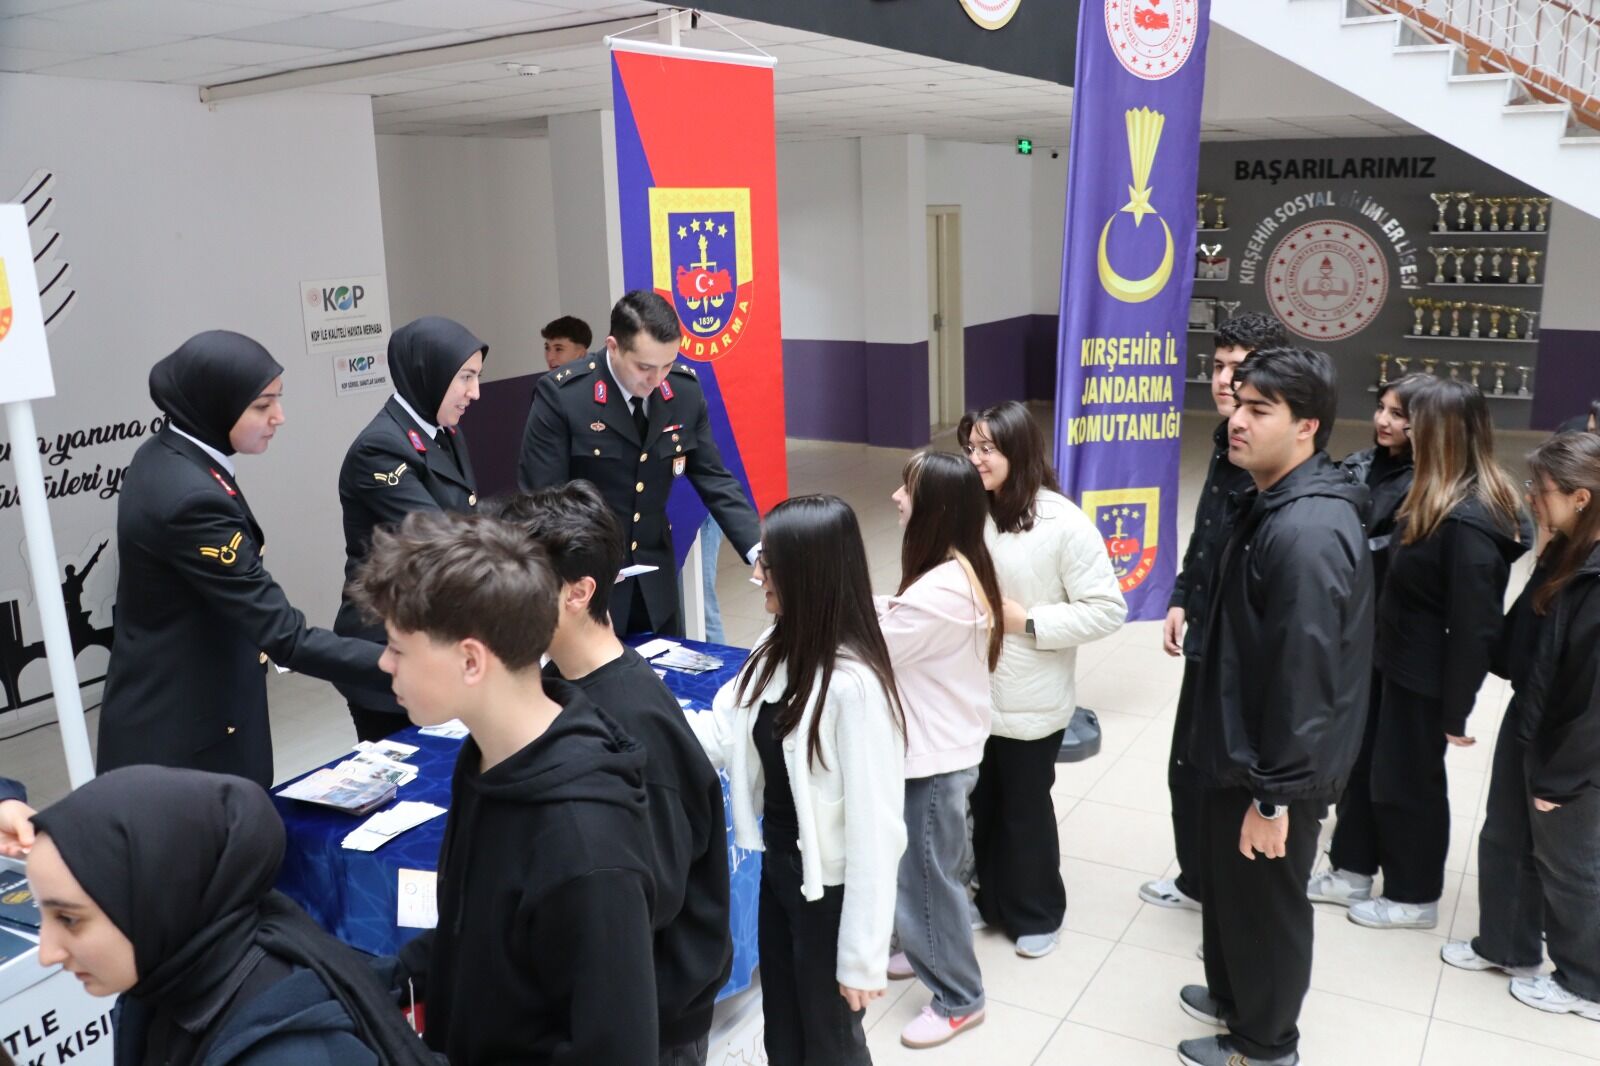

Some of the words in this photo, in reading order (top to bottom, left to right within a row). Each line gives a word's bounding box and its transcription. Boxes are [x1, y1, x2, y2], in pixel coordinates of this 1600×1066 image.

[1234, 157, 1437, 185] BAŞARILARIMIZ
[1239, 216, 1279, 284] KIRŞEHİR
[1274, 190, 1336, 223] SOSYAL
[322, 285, 365, 312] KOP
[681, 301, 749, 356] NDARMA
[699, 316, 714, 326] 1839
[349, 356, 375, 372] KOP
[1081, 331, 1161, 372] KIRŞEHİR
[1165, 331, 1178, 365] İL
[1082, 376, 1173, 405] JANDARMA
[49, 420, 146, 466] yanına
[1067, 406, 1180, 446] KOMUTANLIĞI
[3, 1009, 59, 1056] TLE
[56, 1008, 114, 1064] KISI
